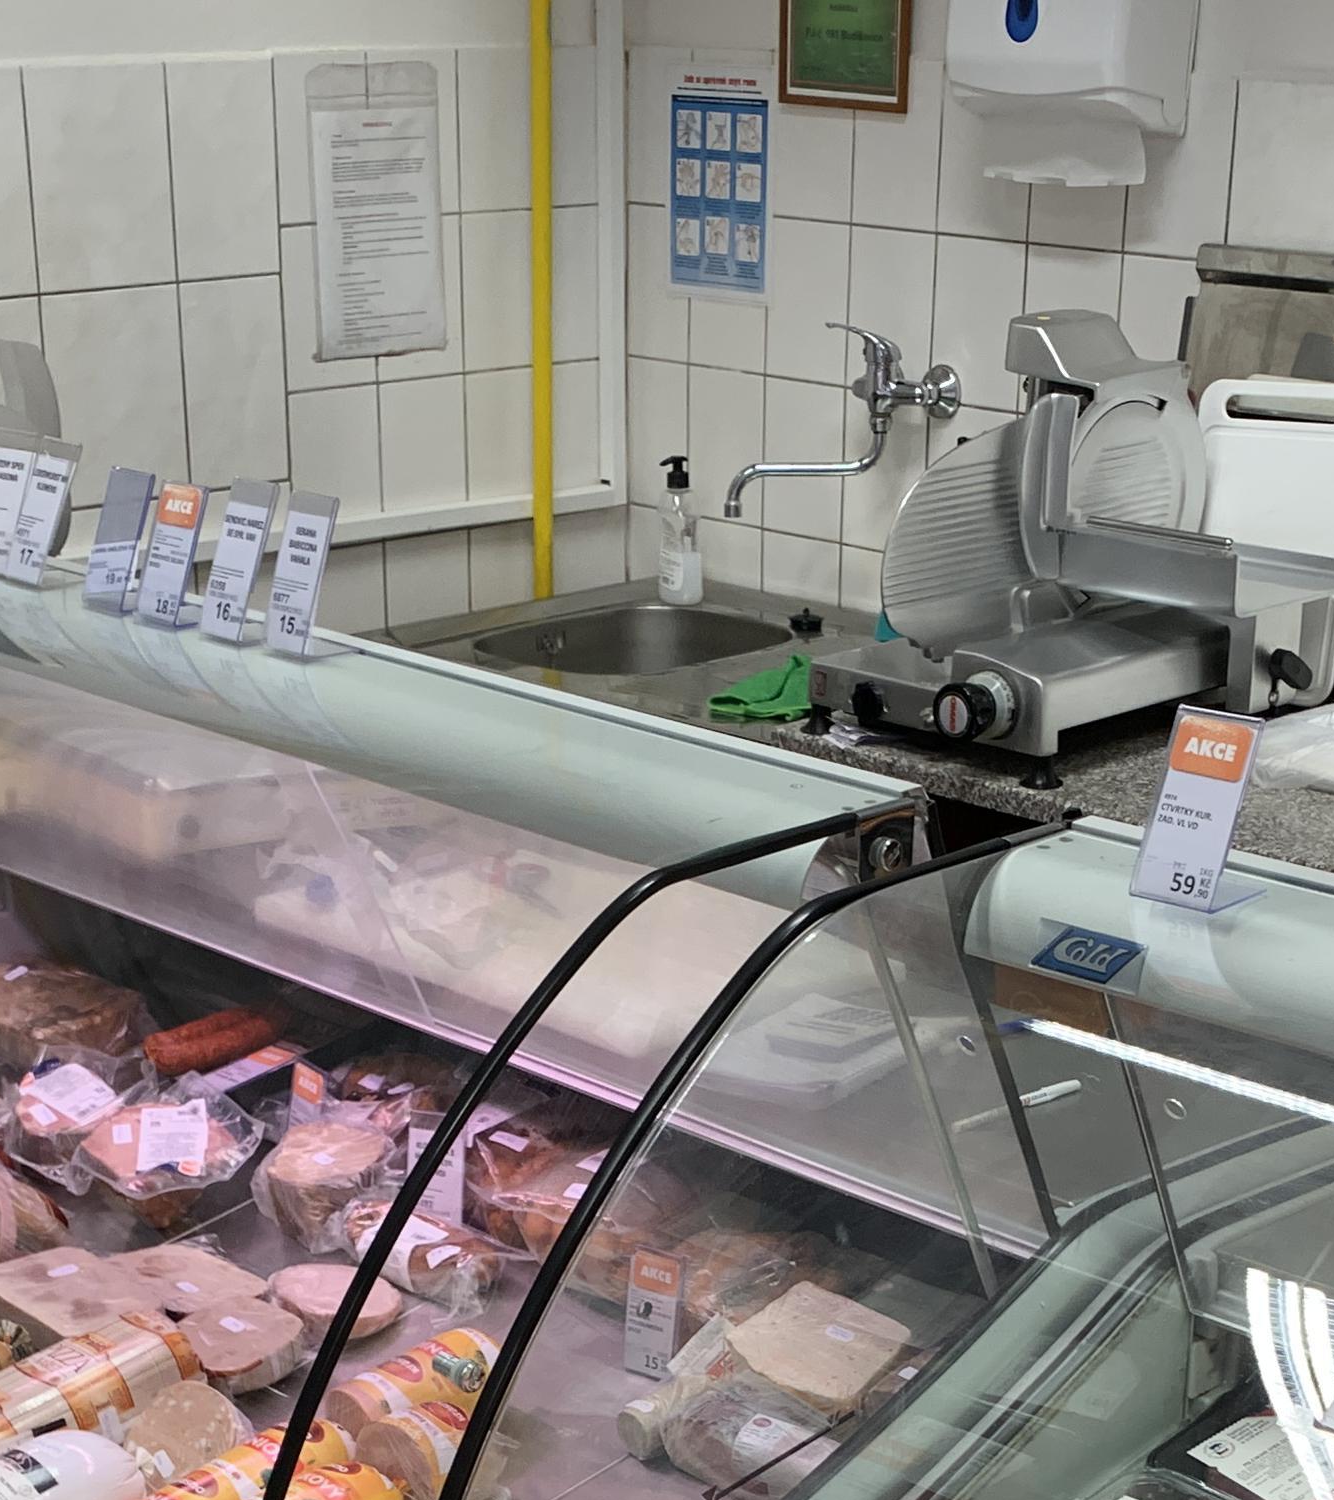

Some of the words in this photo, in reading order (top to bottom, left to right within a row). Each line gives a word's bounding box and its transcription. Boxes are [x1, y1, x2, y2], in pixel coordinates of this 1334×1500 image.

[165, 498, 194, 514] AKCE
[19, 547, 33, 565] 17
[216, 600, 231, 621] 16
[279, 614, 295, 634] 15
[1184, 736, 1237, 762] AKCE
[1161, 803, 1195, 820] CTVRTKY
[1169, 871, 1196, 895] 59
[641, 1265, 672, 1284] AKCE
[644, 1355, 659, 1370] 15
